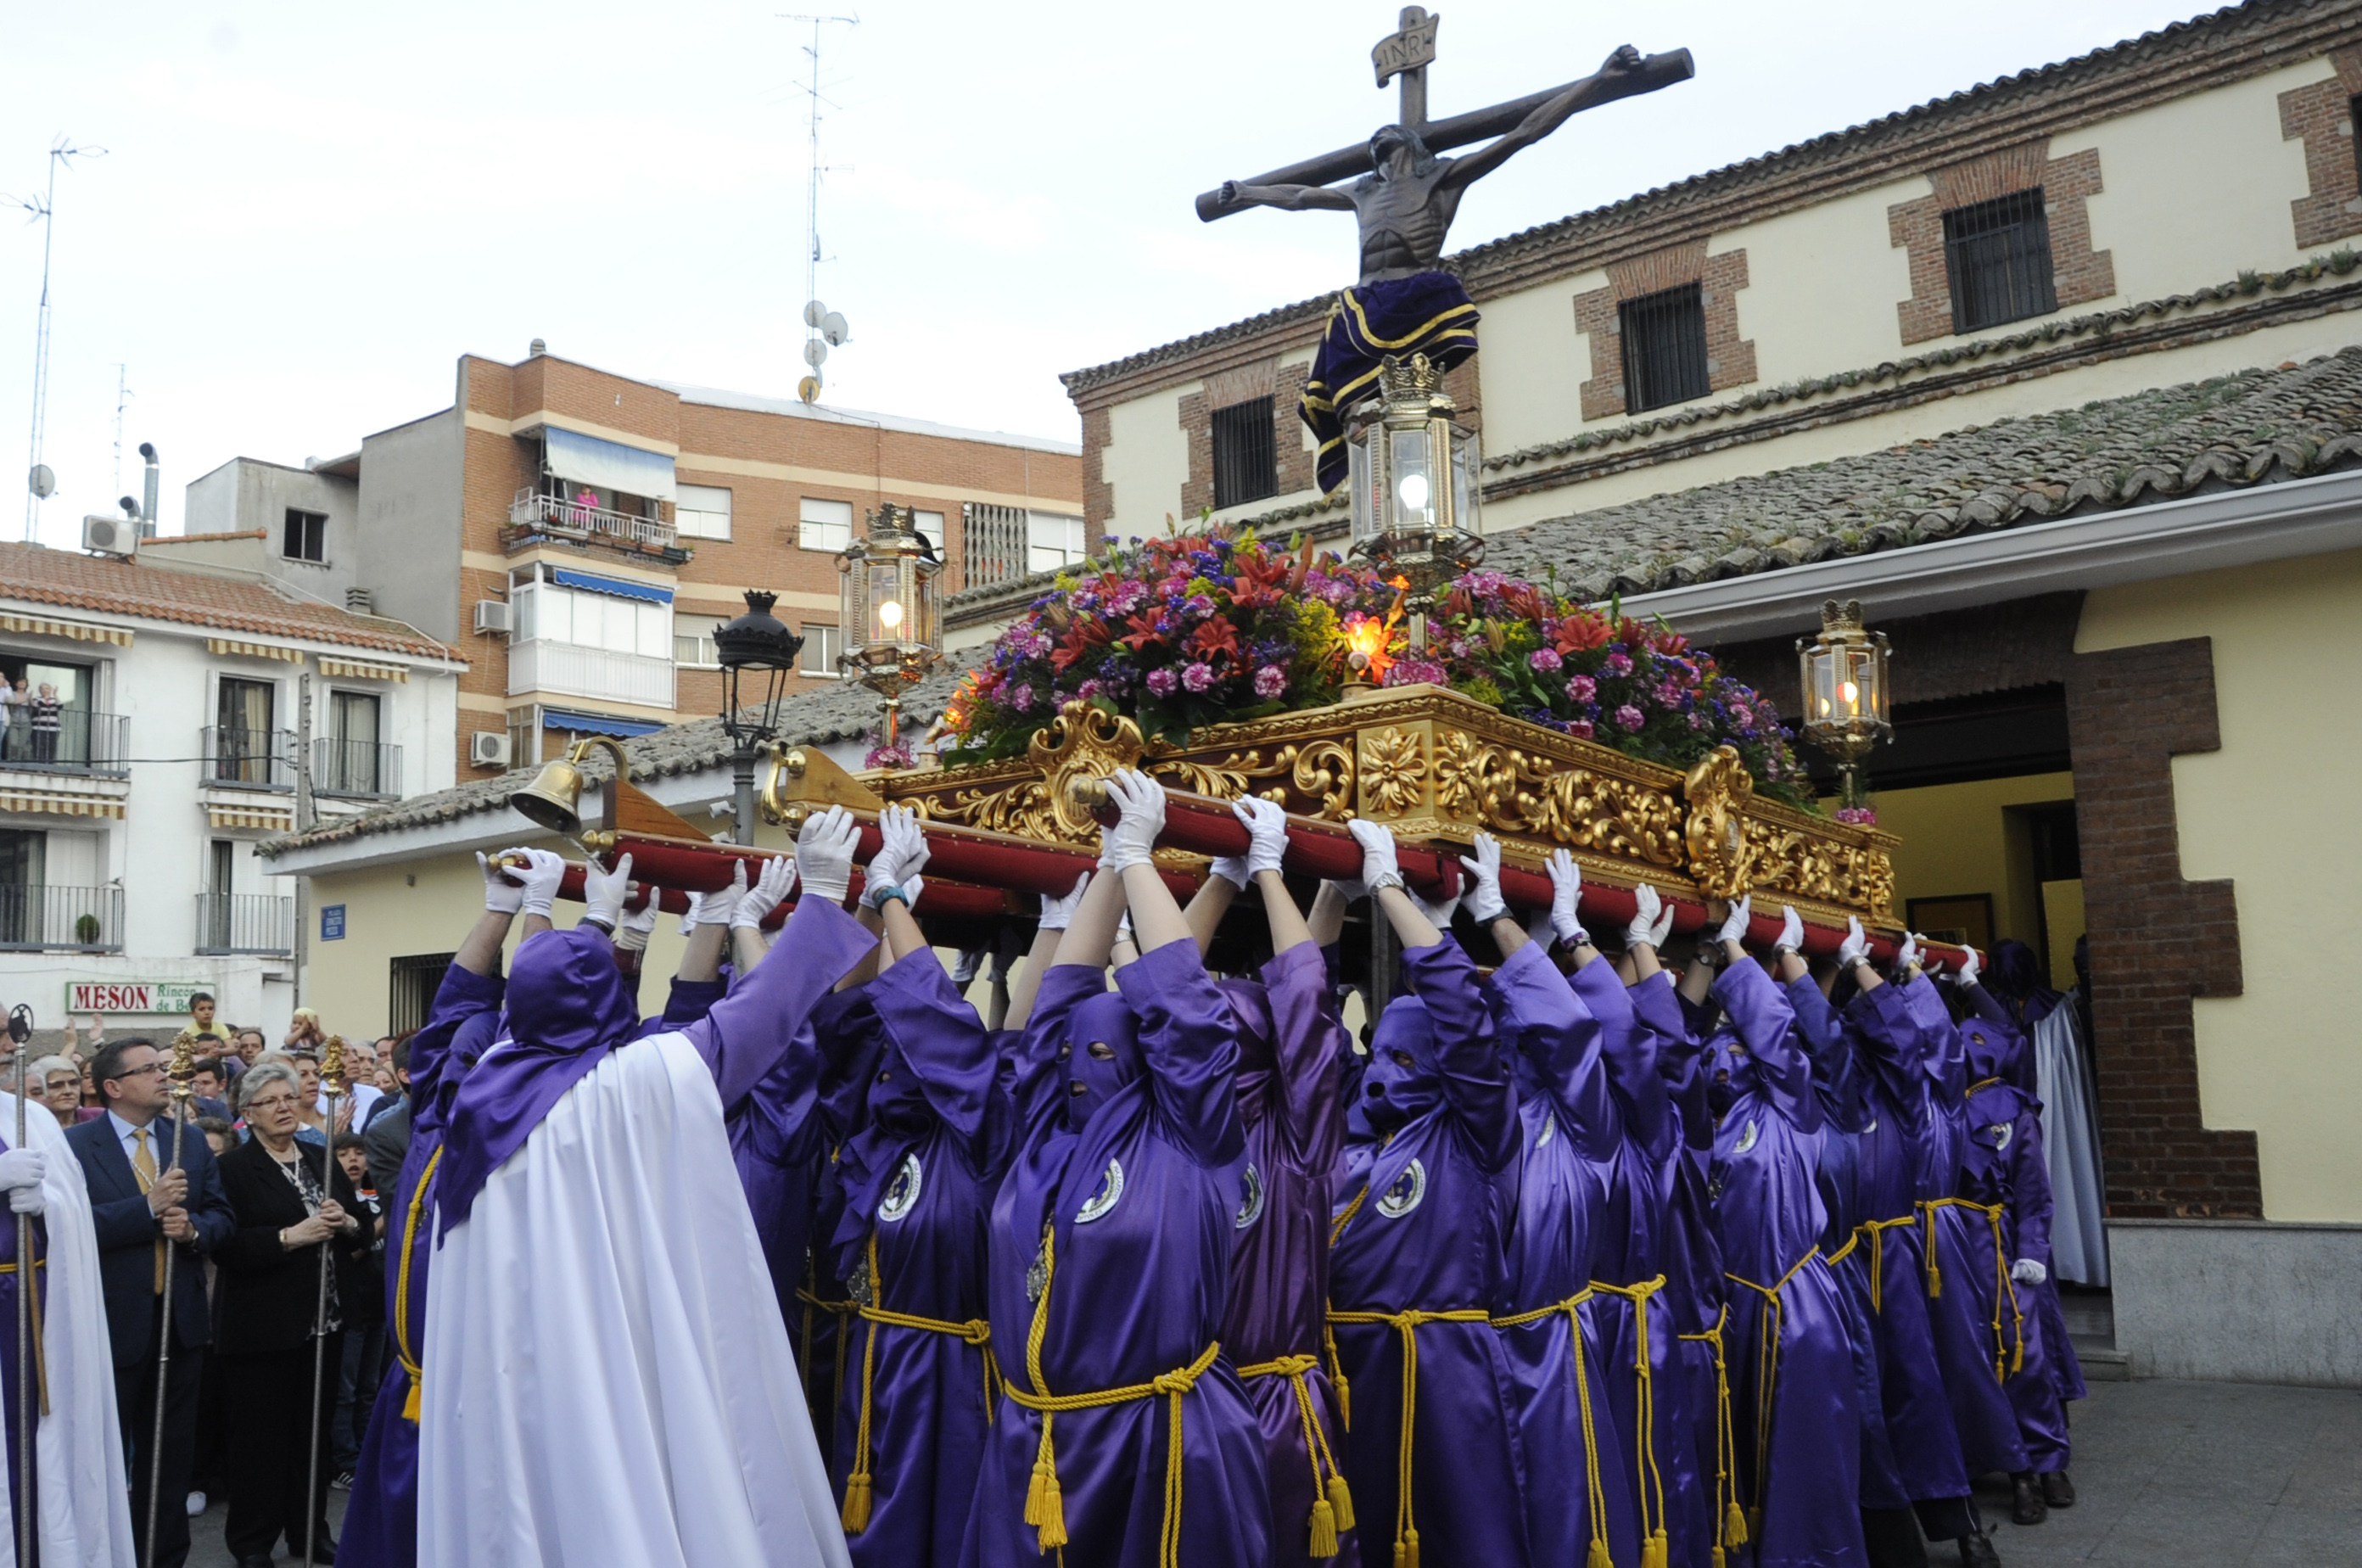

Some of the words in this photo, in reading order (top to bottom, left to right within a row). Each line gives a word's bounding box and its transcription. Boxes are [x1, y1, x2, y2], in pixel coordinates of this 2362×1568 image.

[1382, 32, 1426, 66] INRI
[74, 985, 149, 1010] MESON
[156, 999, 170, 1011] de
